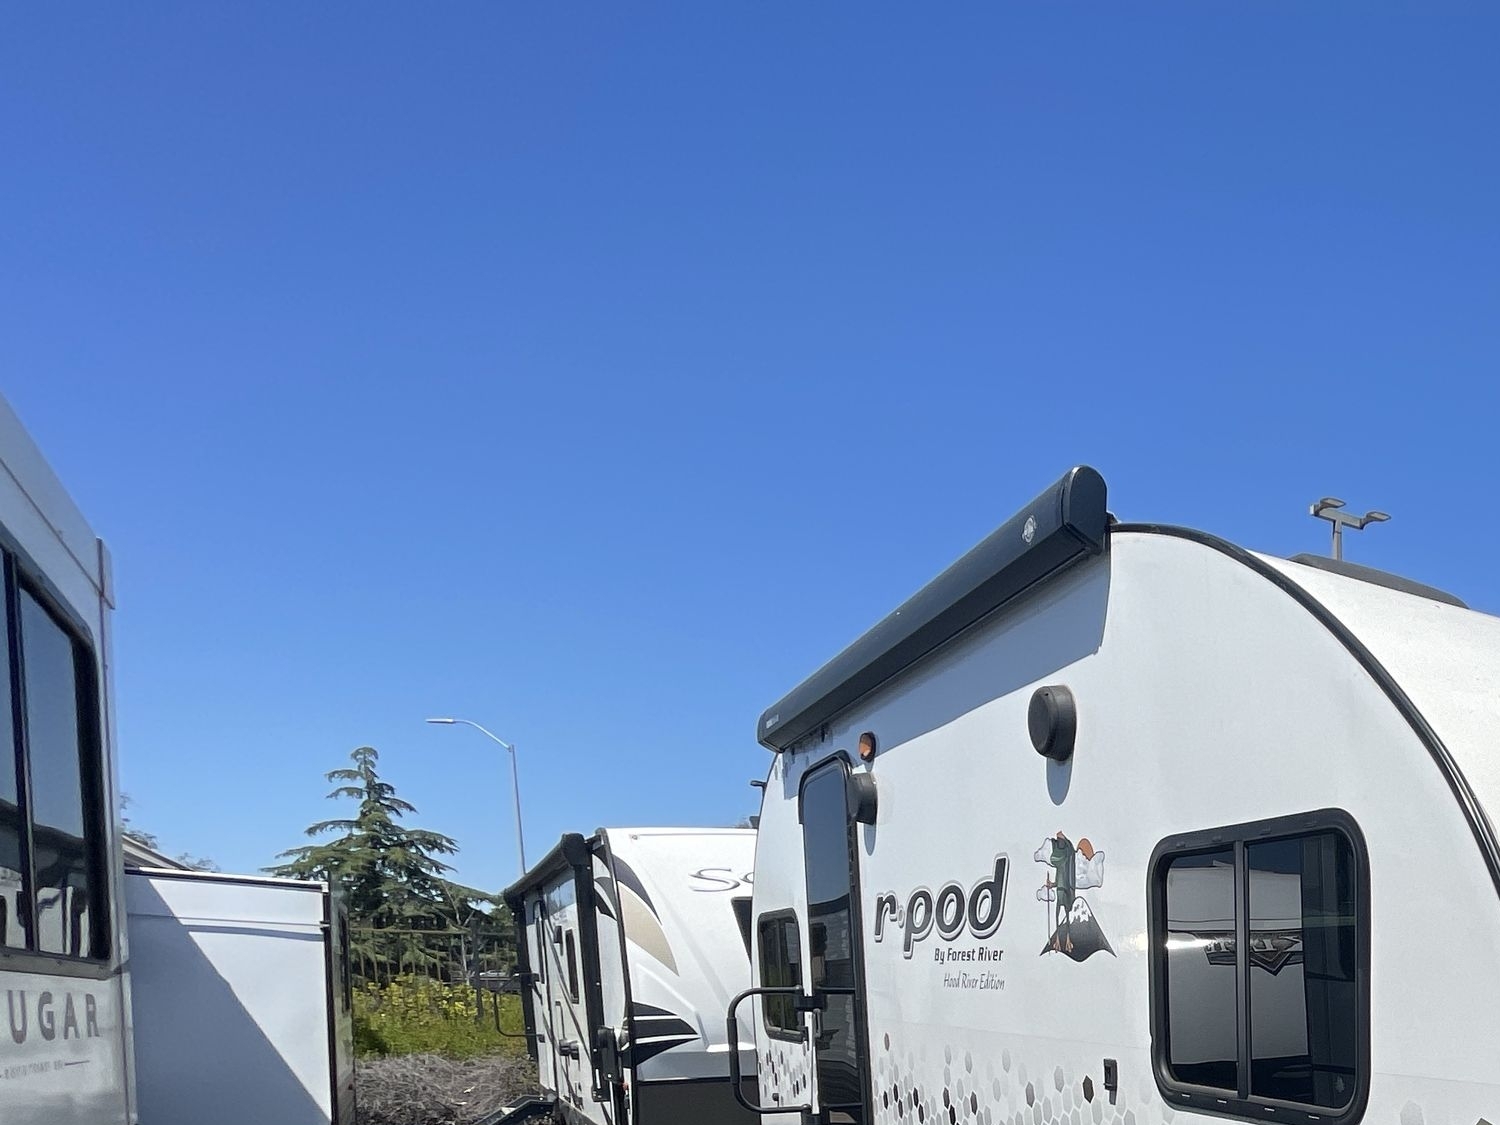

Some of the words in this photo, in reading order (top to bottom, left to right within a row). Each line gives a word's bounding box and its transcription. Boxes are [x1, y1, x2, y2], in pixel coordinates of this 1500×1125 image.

[934, 947, 945, 965] By
[946, 947, 976, 961] Forest
[978, 946, 1004, 961] River
[943, 970, 961, 988] Hood
[961, 972, 979, 988] River
[979, 970, 1005, 990] Edition
